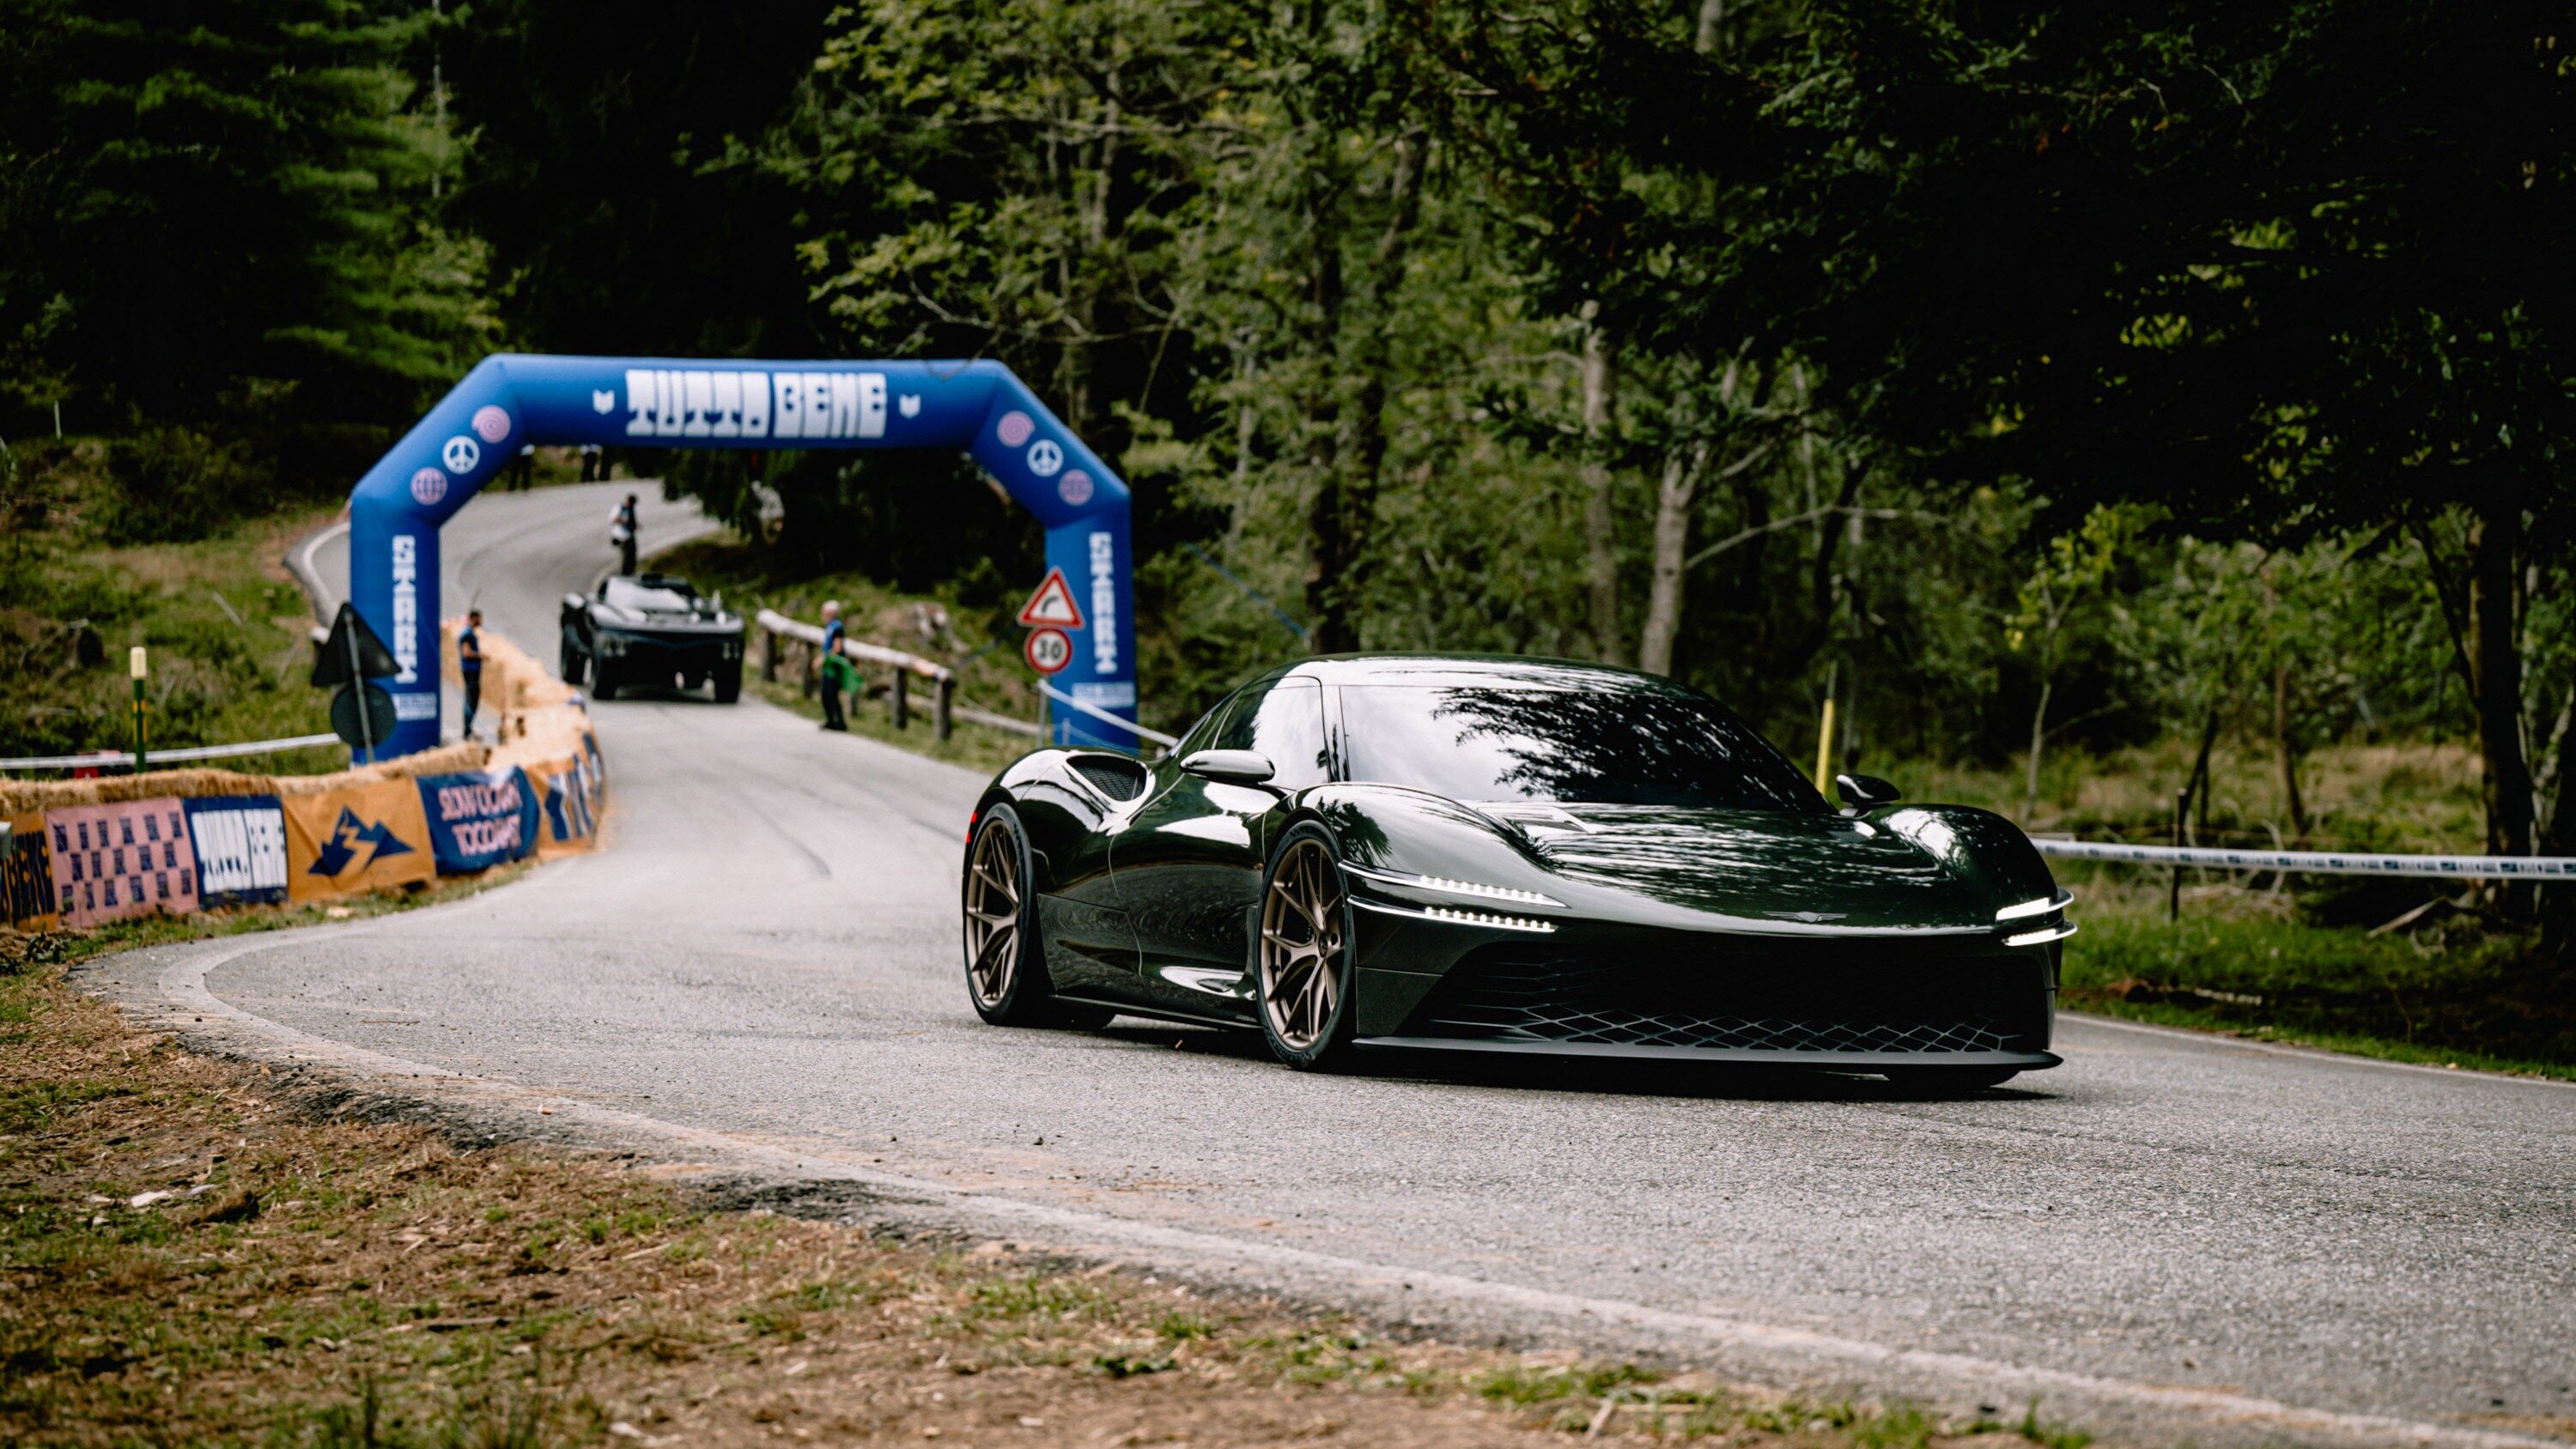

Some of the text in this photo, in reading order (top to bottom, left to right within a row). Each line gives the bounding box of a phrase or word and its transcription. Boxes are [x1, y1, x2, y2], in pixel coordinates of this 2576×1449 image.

[626, 369, 887, 439] TUTTO BENE
[1038, 640, 1062, 660] 30
